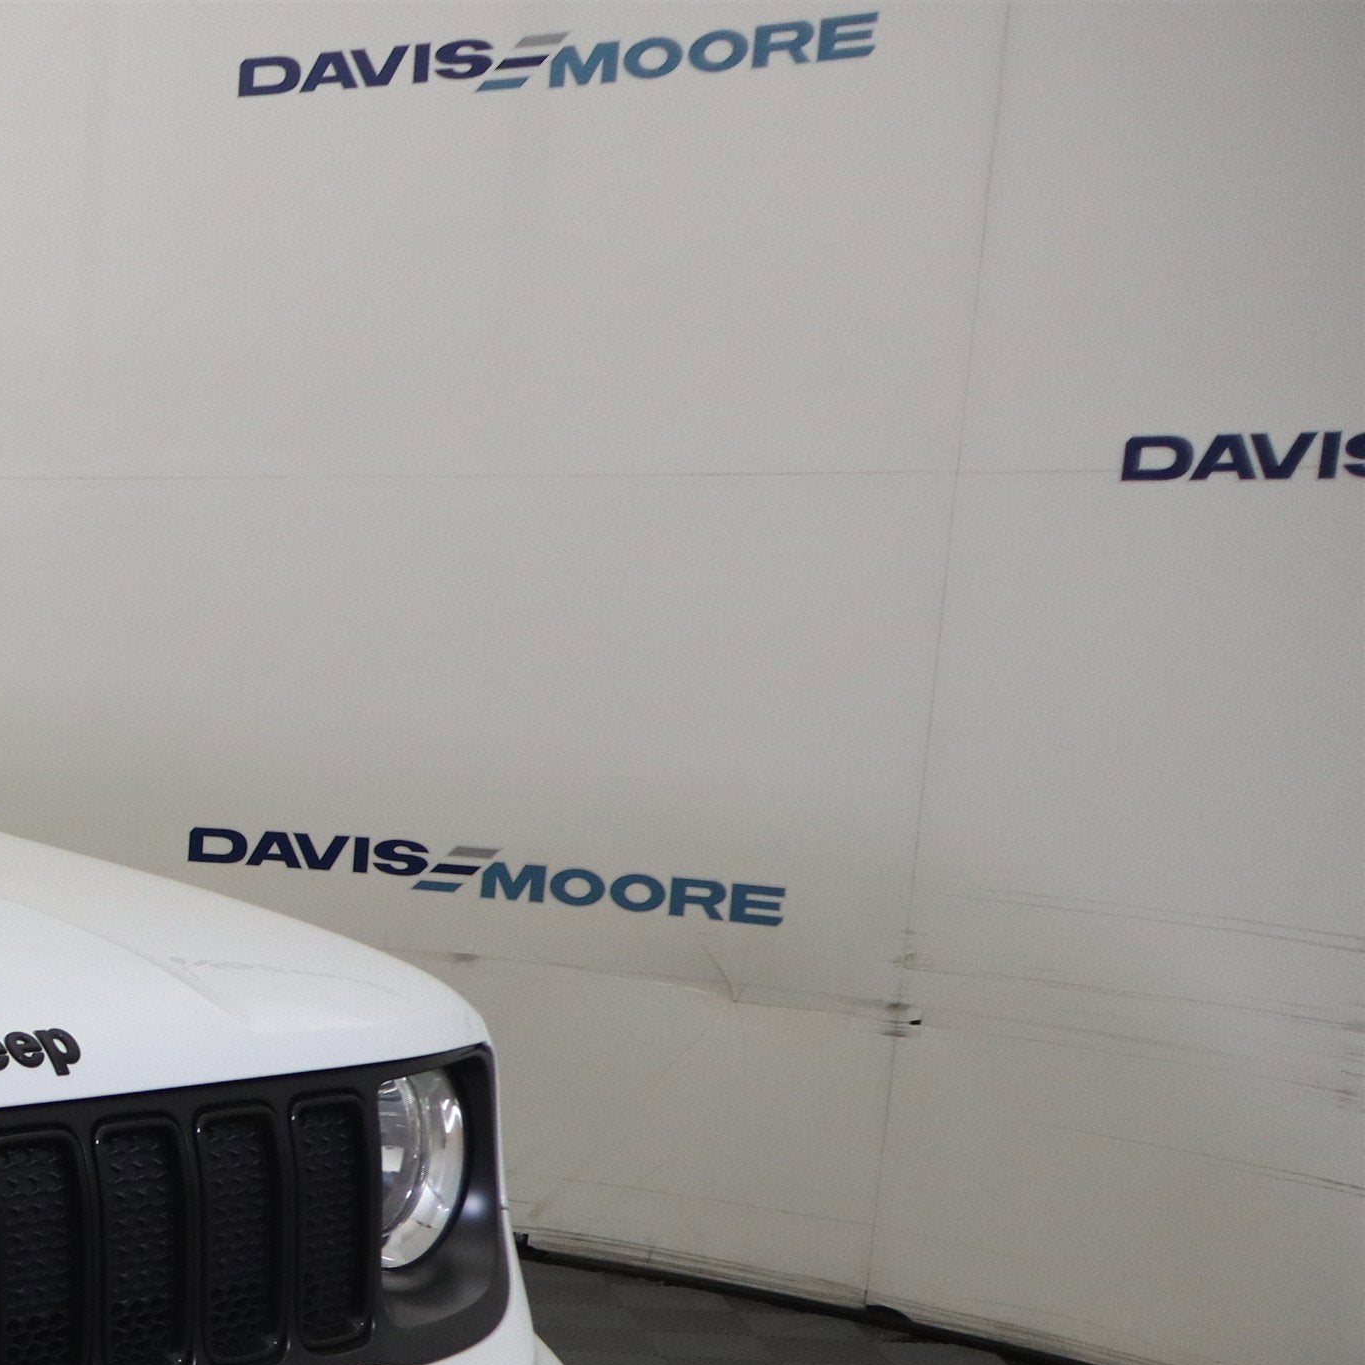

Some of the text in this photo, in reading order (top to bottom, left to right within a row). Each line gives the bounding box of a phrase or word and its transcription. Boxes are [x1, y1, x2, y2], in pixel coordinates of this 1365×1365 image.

[237, 11, 879, 98] DAVIS MOORE
[187, 826, 786, 927] DAVIS MOORE
